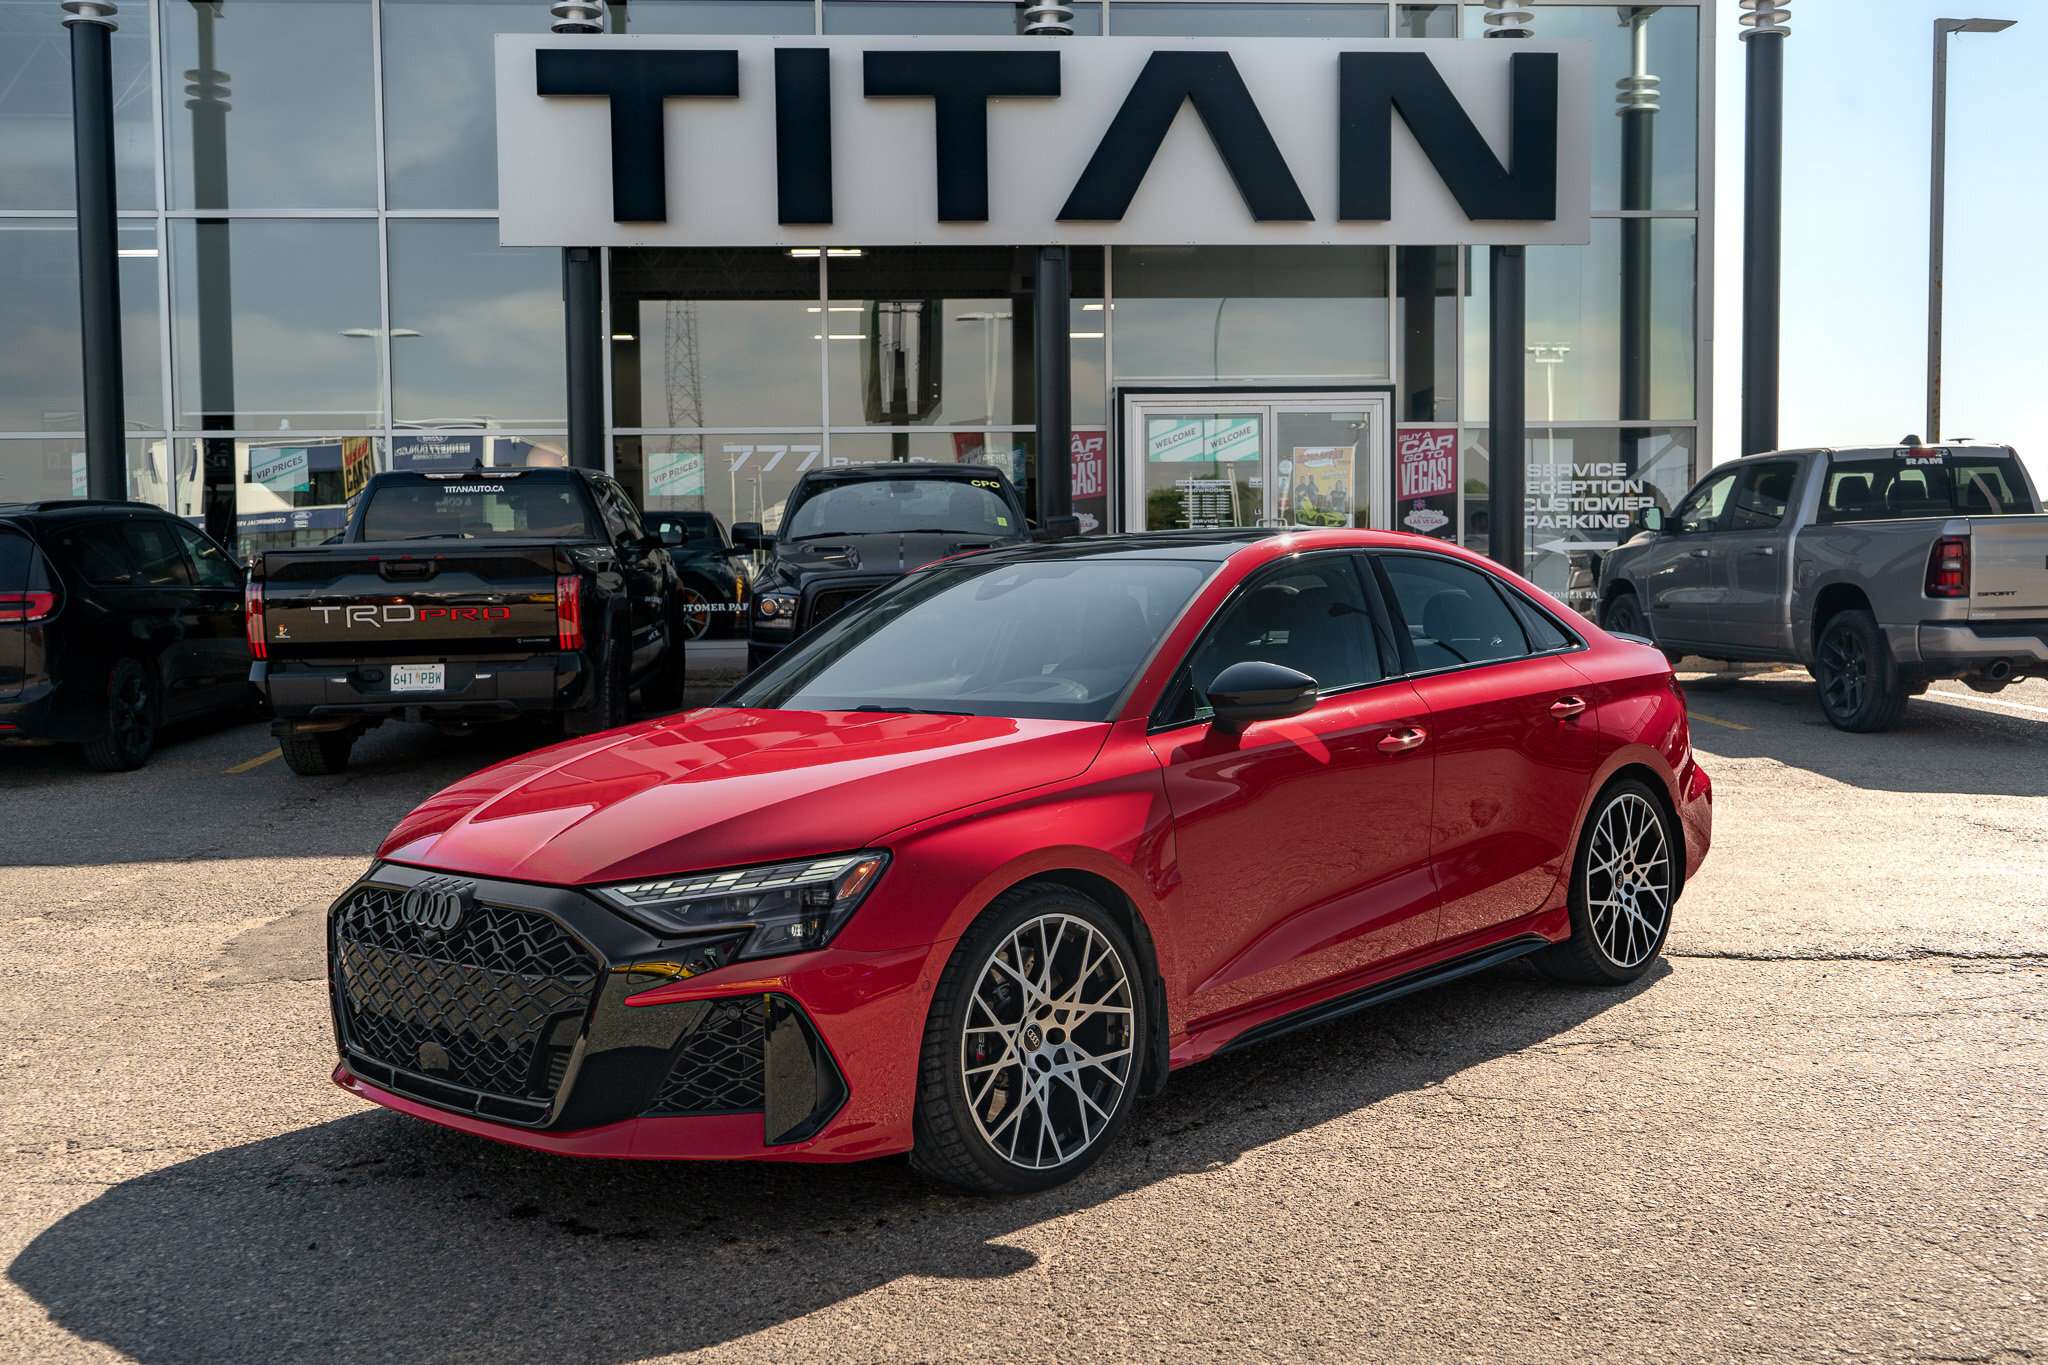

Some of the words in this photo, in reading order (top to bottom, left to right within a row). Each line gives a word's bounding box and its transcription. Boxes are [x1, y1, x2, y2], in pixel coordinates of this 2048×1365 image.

[537, 48, 1558, 225] TITAN
[1155, 427, 1197, 449] WELCOME
[1209, 426, 1252, 449] WELCOME
[1399, 432, 1421, 442] BUY
[1401, 434, 1454, 455] CAR
[1071, 438, 1104, 454] AR
[721, 445, 822, 471] 777
[1074, 452, 1094, 462] TO
[1403, 453, 1424, 463] GO
[1426, 449, 1445, 459] TO
[1905, 457, 1944, 465] RAM
[256, 467, 271, 479] VIP
[272, 456, 304, 473] PRICES
[653, 471, 669, 484] VIP
[668, 460, 699, 478] PRICES
[1526, 462, 1628, 477] SERVICE
[970, 479, 1001, 489] CPO
[1400, 457, 1453, 496] VEGAS!
[443, 485, 505, 493] TITANAUTO.CA
[1524, 480, 1644, 495] ECEPTION
[1524, 496, 1655, 512] CUSTOMER
[1524, 514, 1630, 529] PARKING
[310, 604, 415, 628] TRD
[419, 606, 511, 622] PRO
[393, 672, 412, 685] 641
[421, 671, 442, 684] PBW
